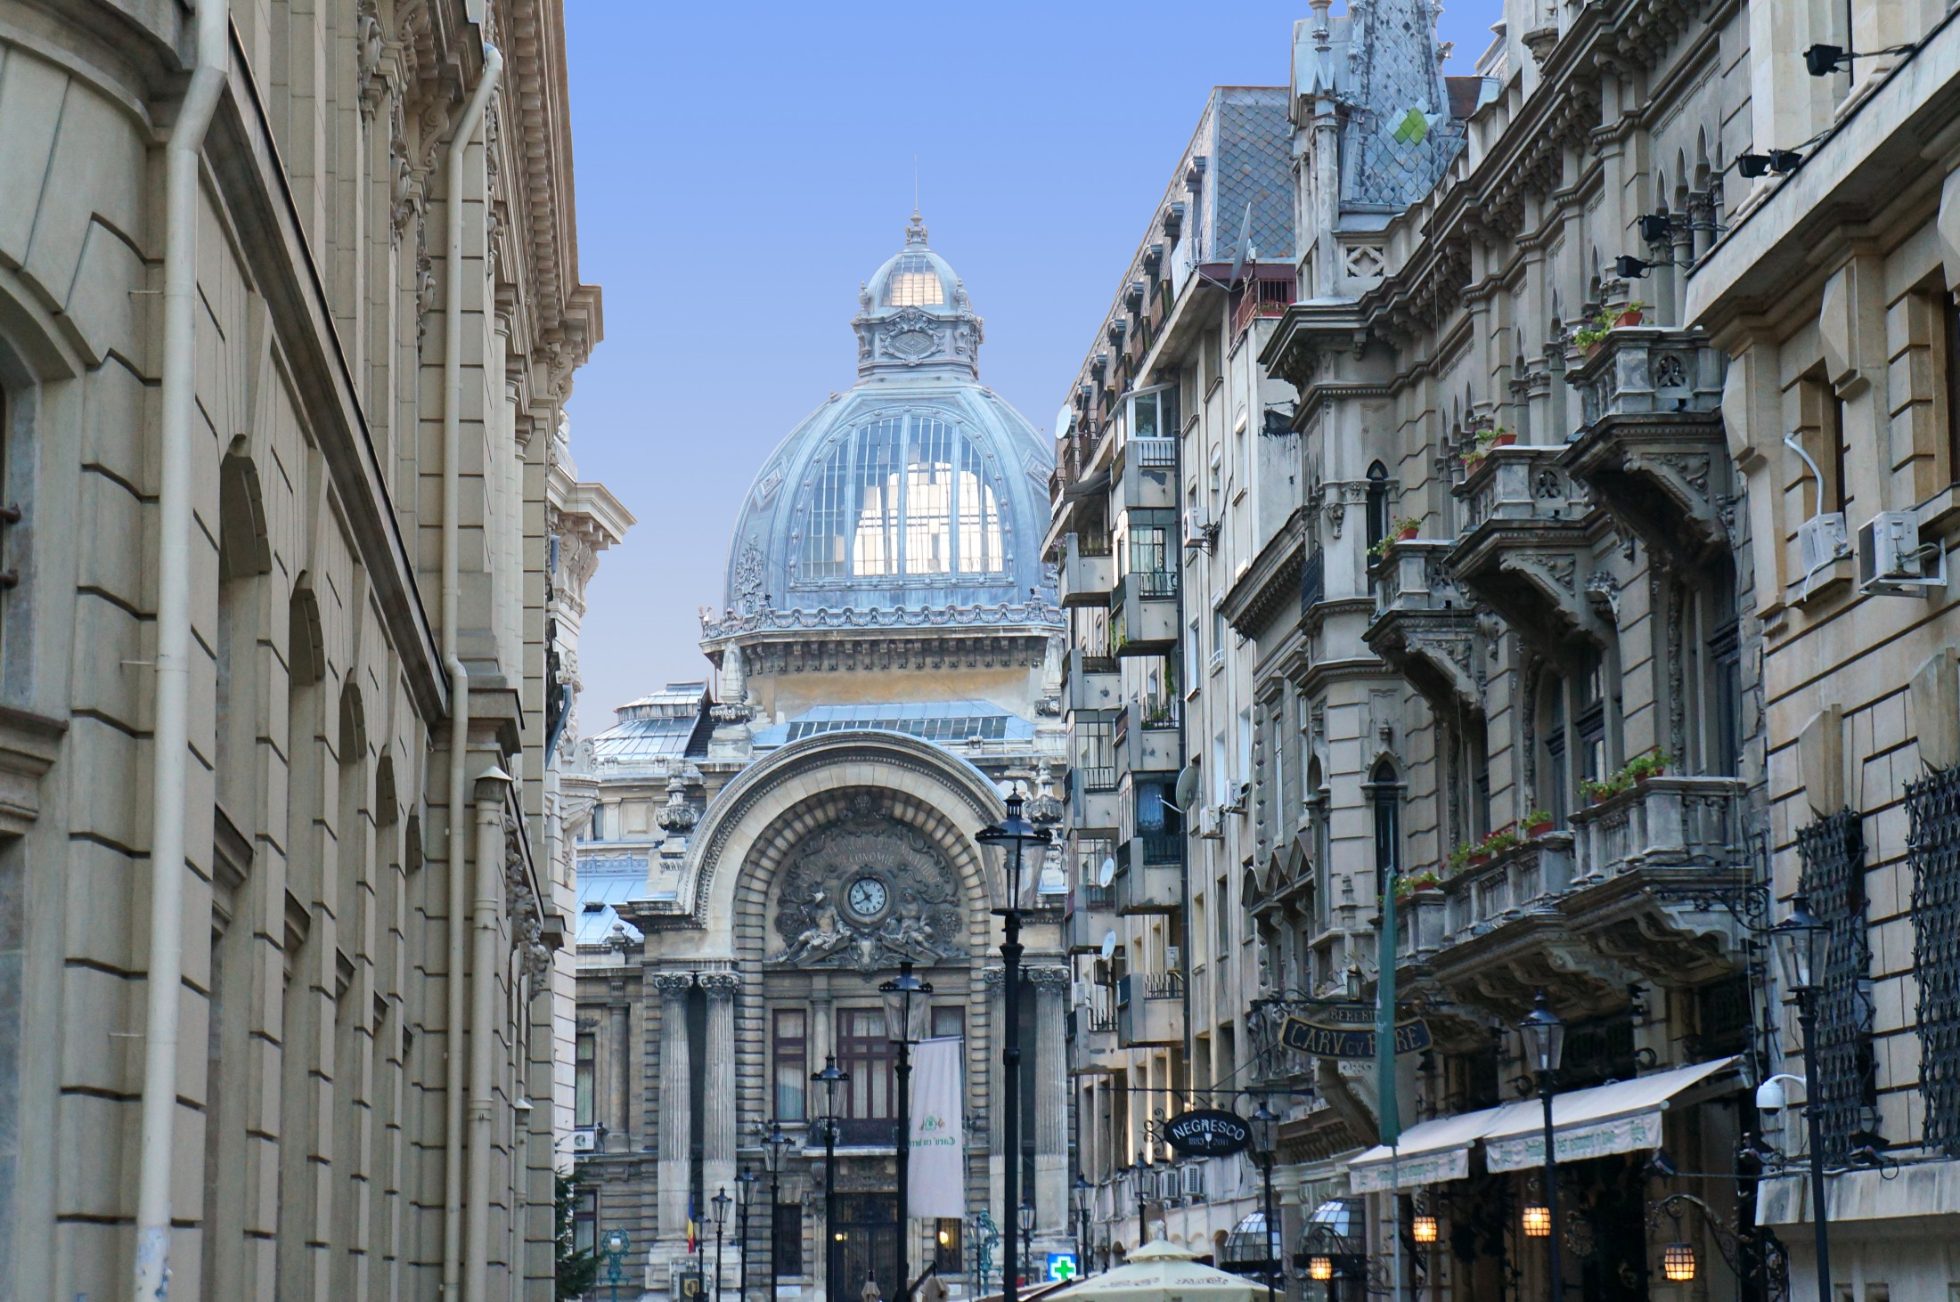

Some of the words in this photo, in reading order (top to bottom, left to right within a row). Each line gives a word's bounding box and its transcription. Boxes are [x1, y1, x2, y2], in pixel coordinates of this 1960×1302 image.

[1330, 1009, 1377, 1022] BERERI
[1368, 1026, 1422, 1055] BRE
[1173, 1119, 1244, 1140] NEGRESCO
